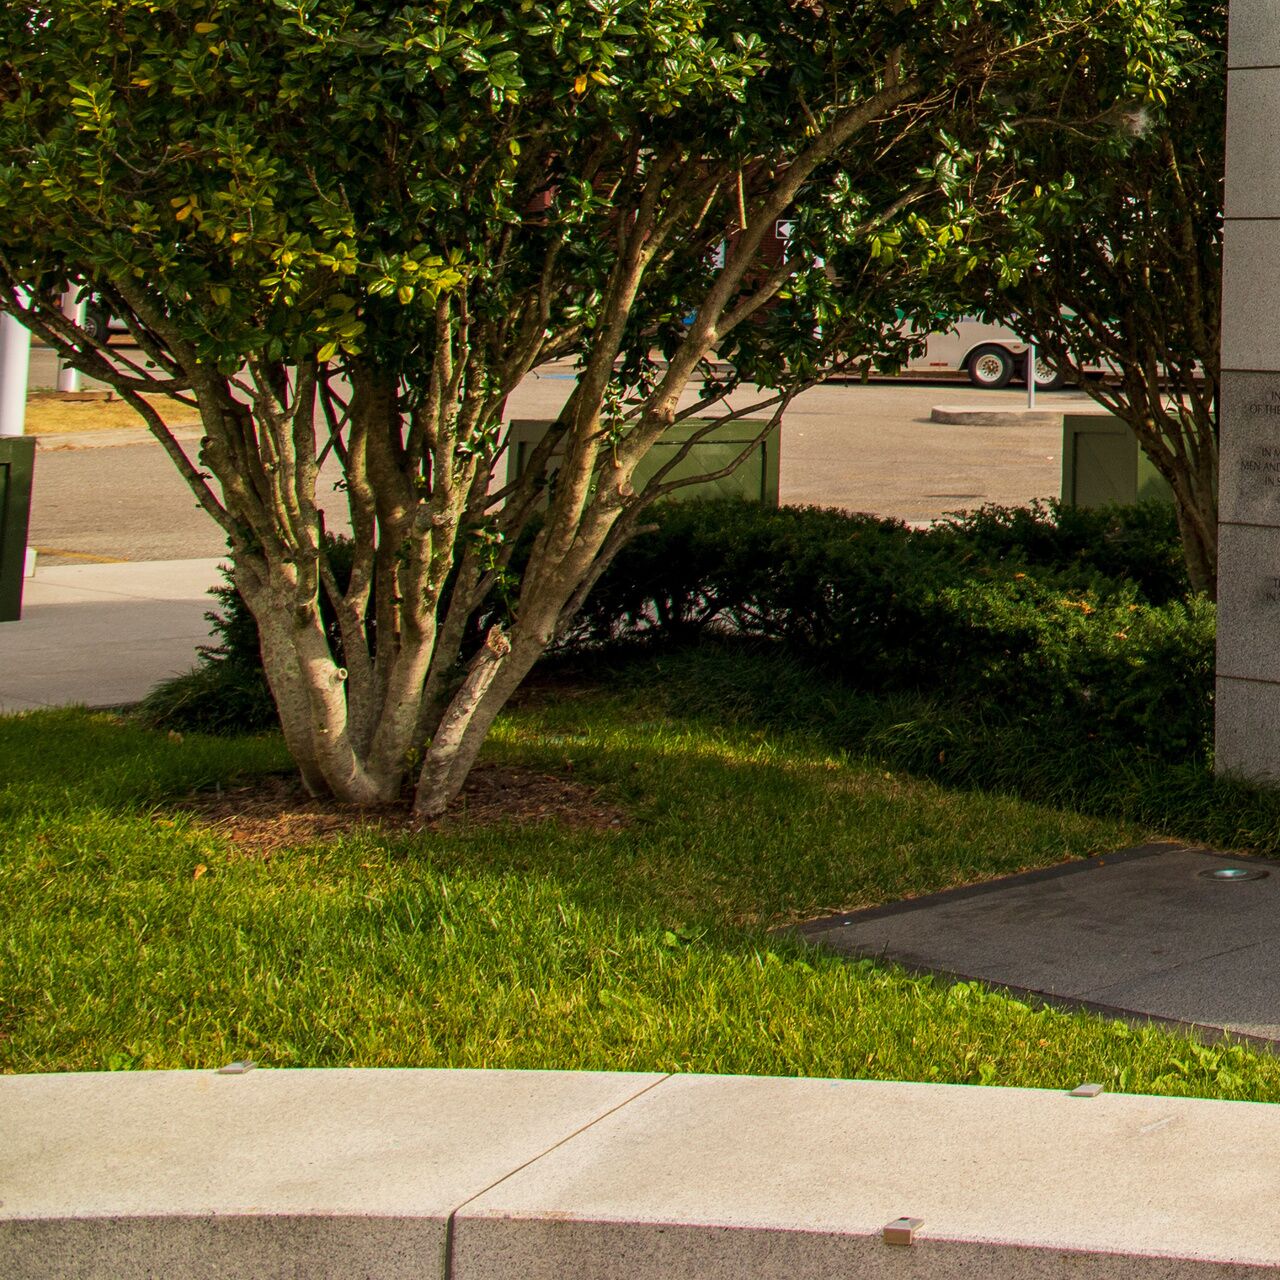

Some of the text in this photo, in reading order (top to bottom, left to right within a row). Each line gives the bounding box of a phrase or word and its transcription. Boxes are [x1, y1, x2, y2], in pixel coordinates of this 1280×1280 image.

[1272, 392, 1280, 401] IN
[1250, 405, 1262, 414] OF
[1265, 405, 1280, 414] THE
[1262, 448, 1271, 457] IN
[1241, 461, 1260, 470] MEN
[1265, 477, 1274, 486] IN
[1266, 593, 1276, 602] IN
